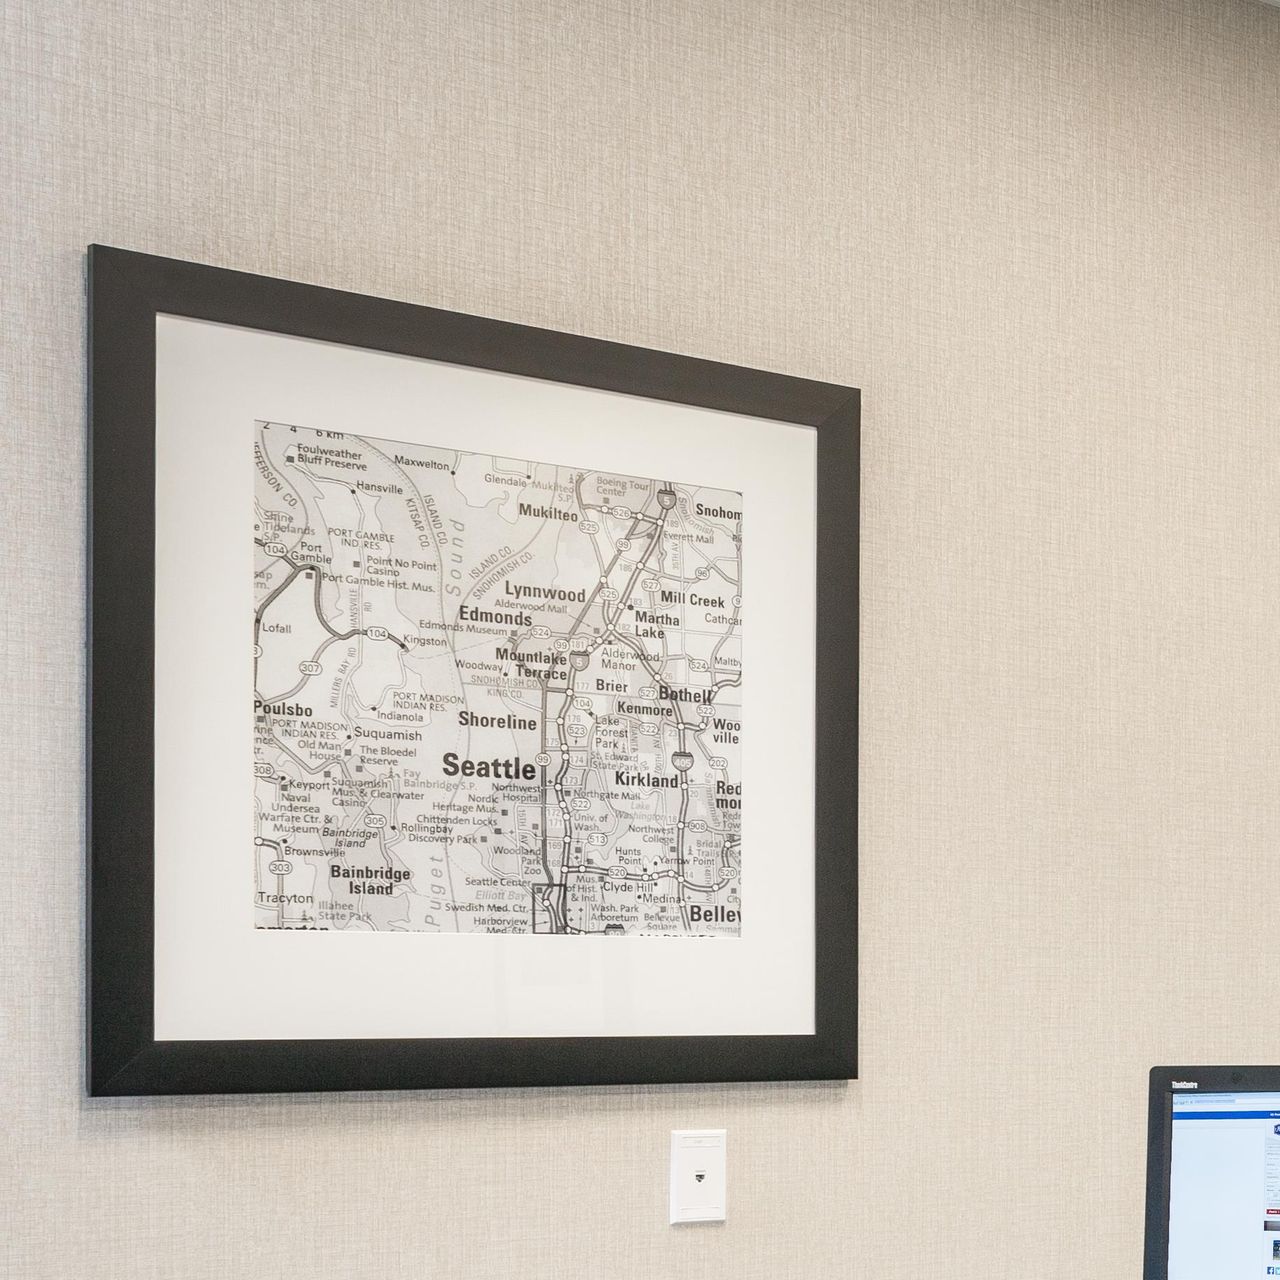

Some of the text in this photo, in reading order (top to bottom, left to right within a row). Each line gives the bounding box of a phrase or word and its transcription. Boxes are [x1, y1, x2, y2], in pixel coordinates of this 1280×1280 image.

[298, 443, 362, 460] Foulweather
[298, 455, 367, 471] Bluff Preserve
[395, 455, 449, 470] Maxwelton
[357, 480, 403, 494] Hansville
[485, 474, 526, 488] Glendale
[519, 503, 578, 522] Mukilteo
[328, 528, 394, 543] PORT GAMBLE
[664, 531, 714, 544] Everett Mall
[301, 542, 322, 552] Port
[291, 552, 331, 564] Gamble
[367, 556, 437, 571] Point Point
[367, 566, 400, 577] Casino
[322, 573, 385, 589] Port Gamble
[505, 580, 586, 603] Lynnwood
[661, 590, 724, 608] Mill Creek
[495, 599, 567, 613] Alderwood Mall
[459, 605, 532, 626] Edmonds
[635, 610, 680, 626] Martha
[263, 623, 291, 634] Lofall
[419, 620, 507, 636] Edmonds Museum
[635, 625, 664, 639] Lake
[403, 635, 447, 647] Kingston
[496, 648, 567, 665] Mountlake
[601, 648, 659, 661] Alderwood
[455, 659, 502, 672] Woodway
[602, 659, 636, 671] Manor
[516, 664, 567, 680] Terrace
[596, 679, 628, 693] Brier
[393, 692, 464, 704] PORT MADISON
[659, 686, 711, 703] Bothell
[254, 701, 312, 717] Poulsbo
[394, 701, 426, 710] INDIAN
[618, 702, 672, 716] Kenmore
[377, 711, 423, 722] Indianola
[459, 711, 537, 730] Shoreline
[596, 716, 619, 726] Lake
[273, 719, 348, 731] PORT MADISON
[282, 729, 314, 738] INDIAN
[354, 727, 422, 741] Suquamish
[596, 727, 628, 738] Forest
[713, 732, 739, 744] ville
[298, 740, 341, 750] Old Man
[596, 739, 618, 749] Park
[310, 750, 342, 761] House
[360, 746, 416, 757] The Bloedel
[361, 756, 398, 766] Reserve
[443, 753, 536, 779] Seattle
[289, 779, 330, 791] Keyport
[332, 777, 388, 790] Suquamish
[615, 770, 678, 788] Kirkland
[492, 783, 541, 793] Northwest
[281, 793, 310, 803] Naval
[371, 790, 424, 800] Clearwater
[468, 794, 498, 804] Nordic
[503, 793, 541, 803] Hospital
[574, 790, 640, 800] Northgate Mall
[332, 797, 367, 807] Casino
[432, 802, 475, 813] Heritage
[272, 803, 320, 814] Undersea
[259, 813, 301, 823] Warfare
[417, 815, 497, 826] Chittenden Locks
[273, 824, 319, 834] Museum
[322, 827, 378, 839] Bainbridge
[401, 823, 453, 835] Rollingbay
[629, 825, 674, 835] Northwest
[335, 838, 366, 848] Island
[408, 833, 477, 846] Discovery Park
[643, 835, 674, 845] College
[285, 846, 345, 858] Brownsville
[494, 846, 541, 856] Woodland
[616, 847, 641, 856] Hunts
[522, 856, 541, 865] Park
[619, 856, 641, 865] Point
[659, 855, 714, 865] Yarrow Point
[331, 865, 410, 881] Bainbridge
[524, 867, 541, 875] Zoo
[349, 882, 393, 896] Island
[603, 882, 653, 893] Clyde Hill
[259, 891, 313, 904] Tracyton
[643, 894, 681, 904] Medina
[445, 903, 484, 913] Swedish
[620, 905, 638, 913] Park
[591, 913, 638, 922] Arboretum
